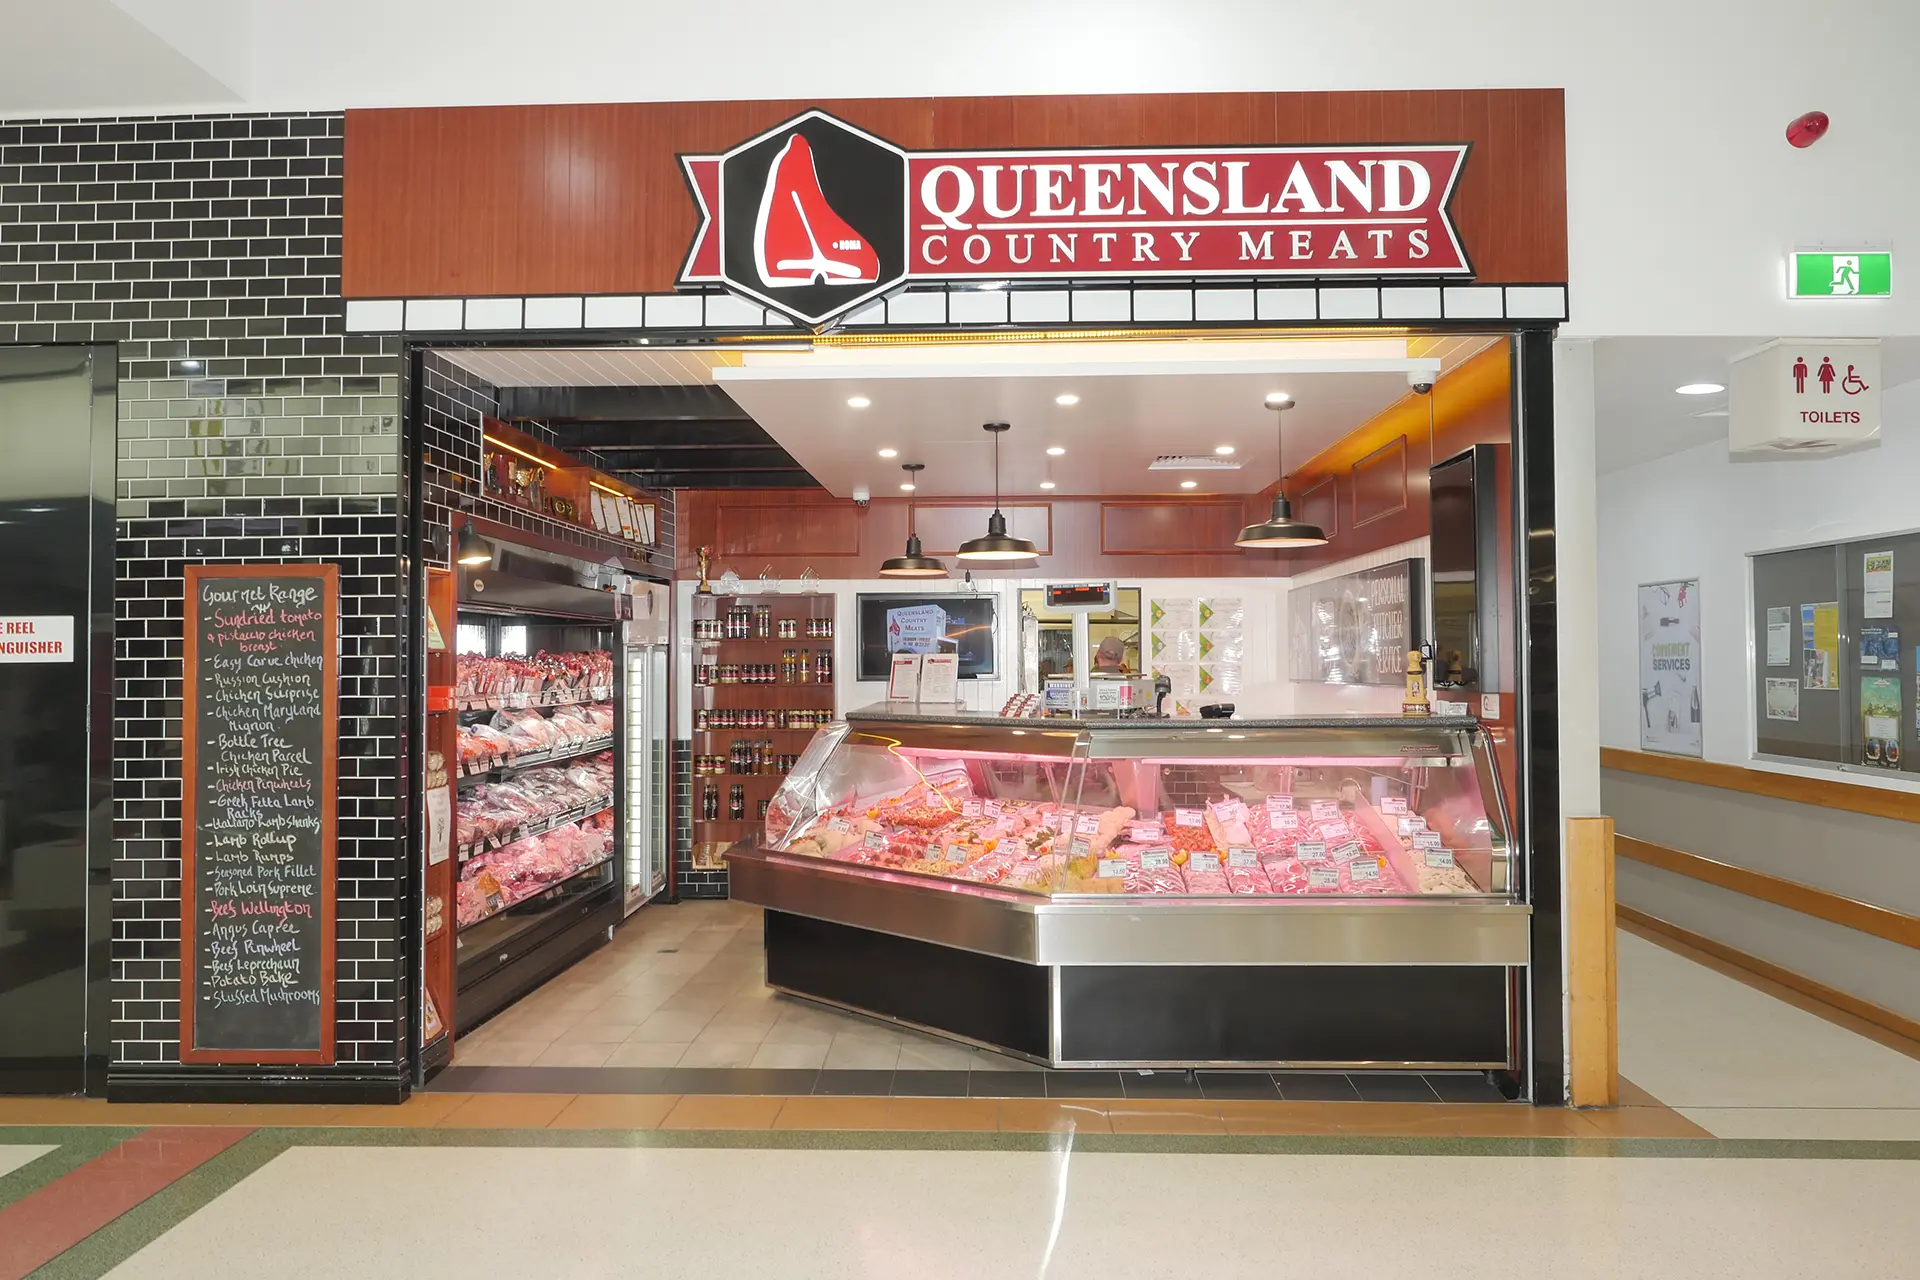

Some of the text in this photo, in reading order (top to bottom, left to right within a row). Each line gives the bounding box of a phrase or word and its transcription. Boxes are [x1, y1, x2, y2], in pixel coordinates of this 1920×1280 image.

[920, 160, 1431, 230] QUEENSLAND
[922, 229, 1430, 265] COUNTRY MEATS
[1800, 411, 1860, 424] TOILETS
[203, 583, 318, 608] Gourmet Range
[1371, 574, 1404, 607] PERSONAL
[215, 609, 322, 628] Sundried tomato
[897, 609, 934, 617] QUEENSLAND
[7, 622, 35, 634] REEL
[269, 629, 316, 642] chicken
[214, 654, 241, 673] Easy
[1376, 646, 1402, 674] SERVICE
[1653, 658, 1691, 671] SERVICES
[262, 673, 311, 688] Cushion
[216, 686, 320, 705] Chicken Surprise
[216, 703, 321, 724] Chicken Maryland
[219, 733, 294, 750] Bottle Tree
[221, 748, 313, 767] Chicken Parcel
[216, 762, 303, 780] Irish Chicken Pie
[216, 777, 312, 793] Chicken Pinwheels
[218, 794, 315, 812] Greek Fetta Lamb
[227, 808, 263, 821] Racks
[259, 814, 286, 830] Lamb
[215, 832, 297, 852] Lamb Rollup
[216, 850, 294, 865] Lamb Rumps
[215, 864, 317, 882] Seasoned Pork Fillet
[214, 881, 314, 899] Pork Loin Supreme
[211, 900, 313, 926] Beef Wellington
[212, 922, 248, 942] Angus
[211, 938, 301, 960] Beef Pinwheel
[237, 958, 301, 974] Leprechaun
[212, 971, 299, 989] Potato Bake
[261, 988, 321, 1006] Mushrooms
